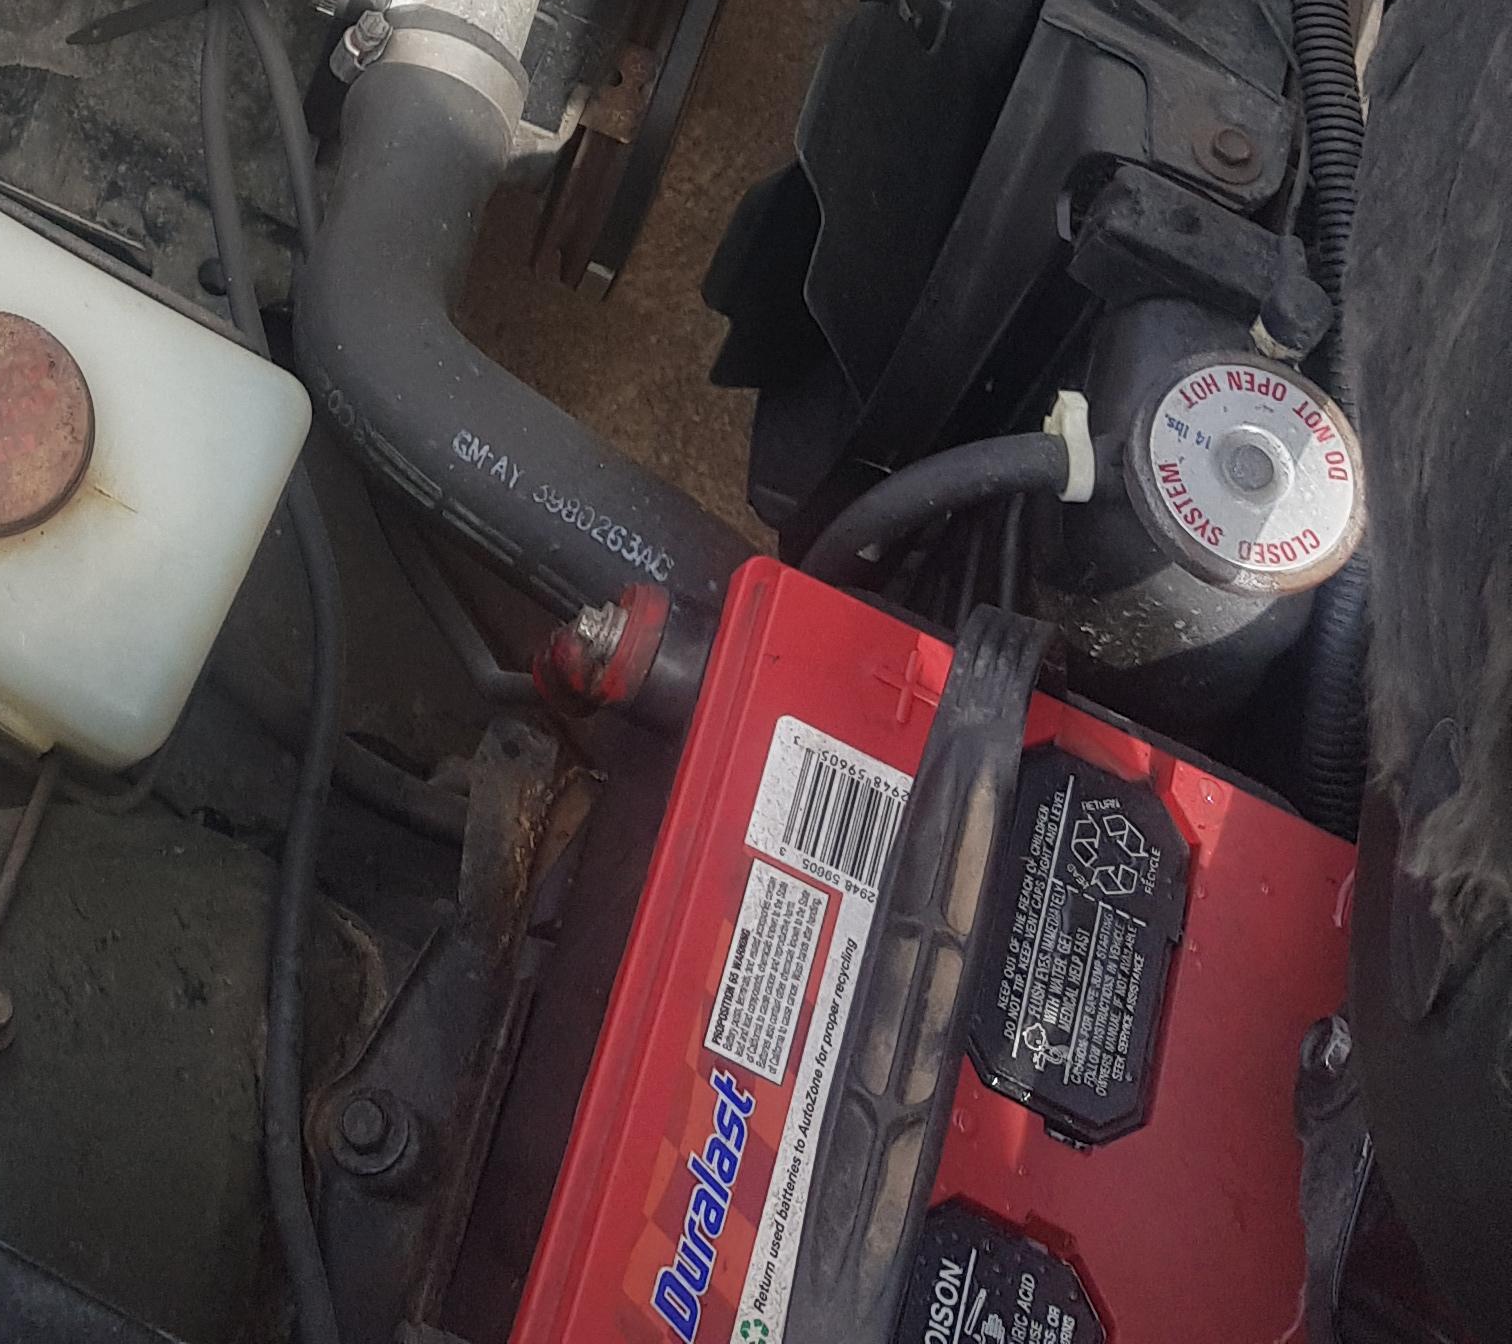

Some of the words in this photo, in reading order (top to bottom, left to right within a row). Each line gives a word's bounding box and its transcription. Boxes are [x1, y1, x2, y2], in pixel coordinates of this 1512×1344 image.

[1178, 372, 1221, 410] HOT
[1226, 370, 1287, 402] OPEN
[1292, 399, 1336, 444] NOT
[1324, 450, 1348, 482] DO
[1157, 461, 1226, 547] SYSTEM
[1238, 527, 1322, 565] CLOSED
[793, 735, 801, 745] 3
[821, 749, 866, 781] 59605
[1049, 788, 1065, 821] LEVEL
[1029, 803, 1049, 856] CHILDREN
[1044, 820, 1057, 846] AND
[779, 846, 787, 857] 3
[1037, 846, 1053, 879] TIGHT
[1017, 874, 1034, 913] REACH
[1029, 877, 1046, 910] CAPS
[1013, 910, 1026, 934] THE
[1024, 908, 1039, 940] VENT
[731, 927, 750, 970] WARNING
[1008, 935, 1021, 954] OF
[1018, 939, 1033, 971] KEEP
[1072, 925, 1090, 956] FAST
[727, 970, 739, 984] 65
[833, 936, 858, 1000] recycling
[1003, 955, 1016, 978] OUT
[1042, 994, 1061, 1025] WITH
[1057, 930, 1073, 955] GET
[1067, 953, 1085, 986] HELP
[1122, 950, 1146, 1013] ASSISTANCE
[996, 978, 1012, 1010] KEEP
[1027, 981, 1047, 1019] FLUSH
[1114, 973, 1128, 997] NOT
[711, 983, 735, 1046] PROPOSITION
[820, 995, 842, 1047] proper
[1007, 993, 1022, 1020] NOT
[1057, 984, 1079, 1034] MEDICAL
[1003, 1019, 1017, 1040] DO
[1116, 1012, 1135, 1055] SERVICE
[814, 1044, 828, 1067] for
[1110, 1053, 1126, 1082] SEEK
[797, 1067, 823, 1139] AutoZone
[793, 1135, 807, 1154] to
[776, 1154, 800, 1220] batteries
[650, 1069, 756, 1344] Duralast
[767, 1219, 785, 1258] used
[753, 1259, 774, 1314] Return
[924, 1257, 964, 1344] OISON
[1017, 1272, 1036, 1314] ACID
[1046, 1304, 1061, 1328] OR
